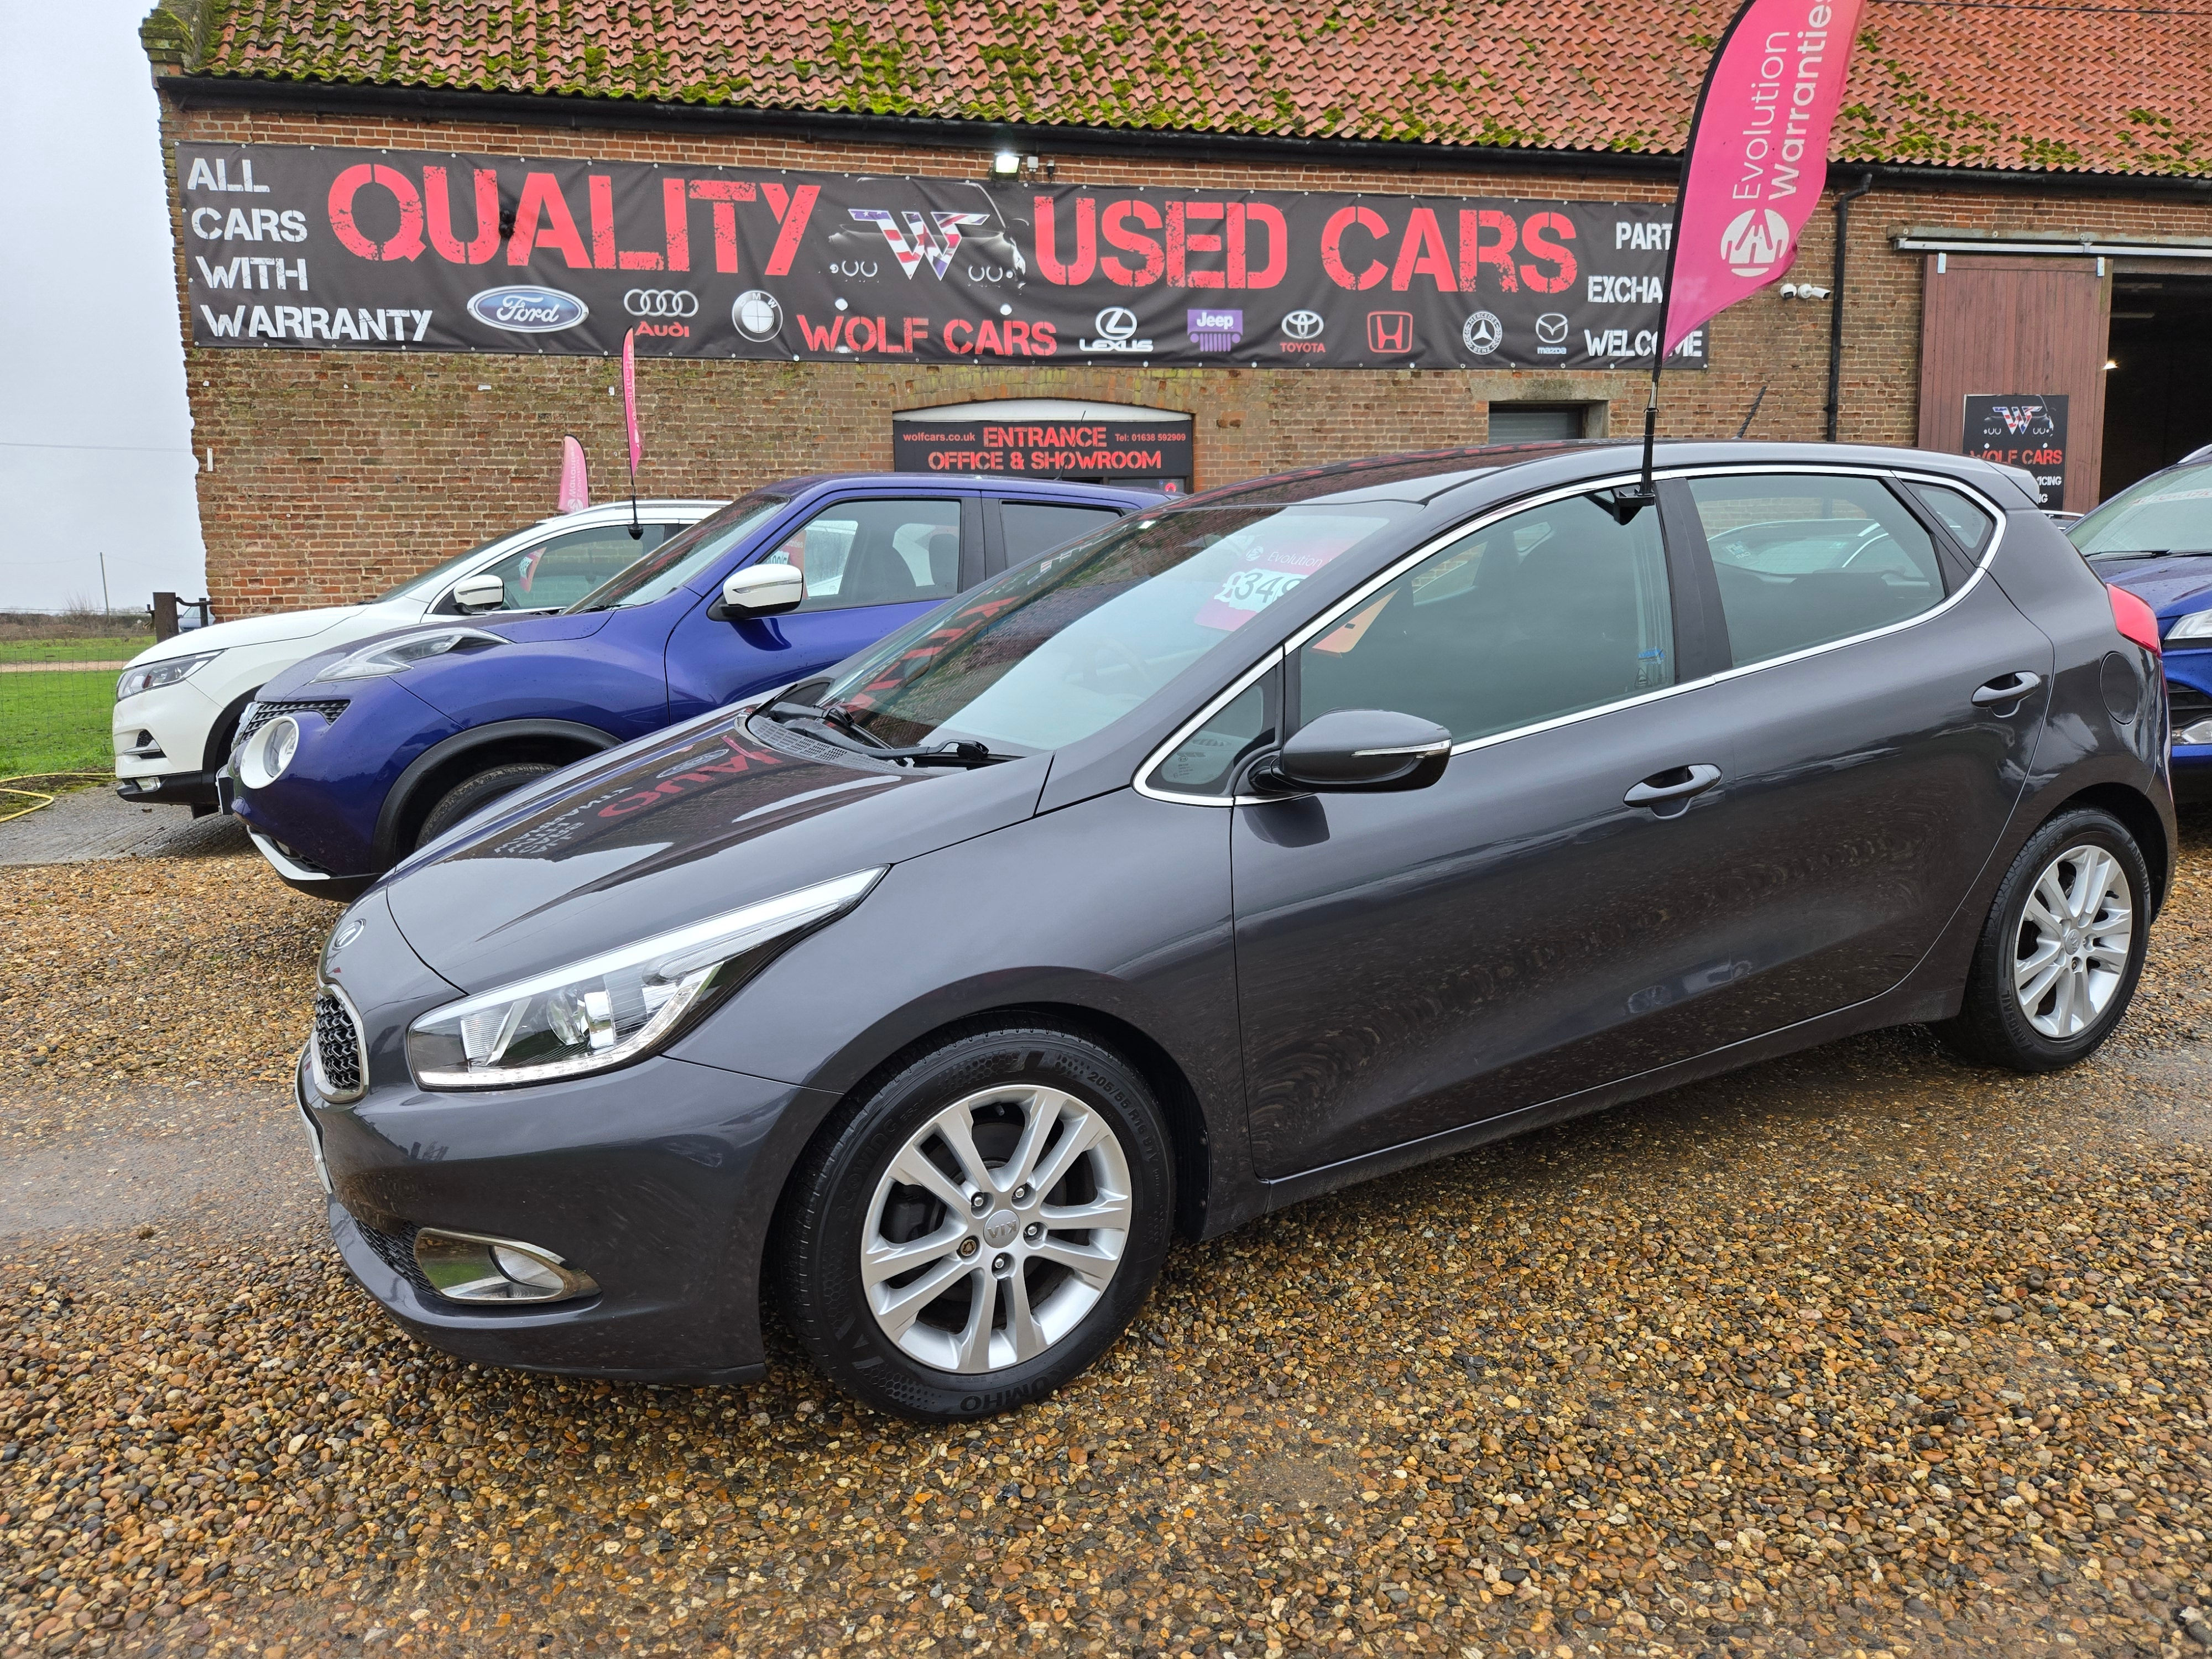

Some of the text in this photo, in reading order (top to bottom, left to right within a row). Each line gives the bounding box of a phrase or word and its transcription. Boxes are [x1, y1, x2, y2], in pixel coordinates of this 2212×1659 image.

[1768, 0, 1833, 200] Warrantie
[1733, 32, 1790, 200] Evolution
[187, 158, 270, 192] ALL
[191, 207, 308, 242] CARS
[327, 163, 1578, 294] QUALITY USED CARS
[1616, 221, 1673, 251] PART
[196, 255, 309, 291] WITH
[739, 292, 778, 309] BMW
[1588, 275, 1663, 304] EXCHA
[200, 304, 433, 342] WARRANTY
[496, 294, 560, 328] Ford
[1196, 311, 1234, 330] Jeep
[1468, 313, 1498, 325] MERCEDES
[634, 321, 690, 338] Audi
[796, 314, 1057, 356] WOLF CARS
[1079, 339, 1154, 352] LEXUS
[1280, 342, 1326, 353] TOYOTA
[1537, 346, 1567, 354] mazda
[902, 426, 1186, 448] wolfcars.co.uk ENTRANCE Tel: 01638 592909
[928, 450, 1162, 470] OFFICE & SHOWROOM
[2022, 450, 2063, 465] CARS
[2037, 476, 2062, 486] ICING
[1268, 551, 1323, 568] Evolution
[1087, 1071, 1131, 1109] 205/55
[1128, 1108, 1148, 1134] R16
[987, 1219, 1018, 1239] KIA
[959, 1363, 1067, 1411] KUMHO
